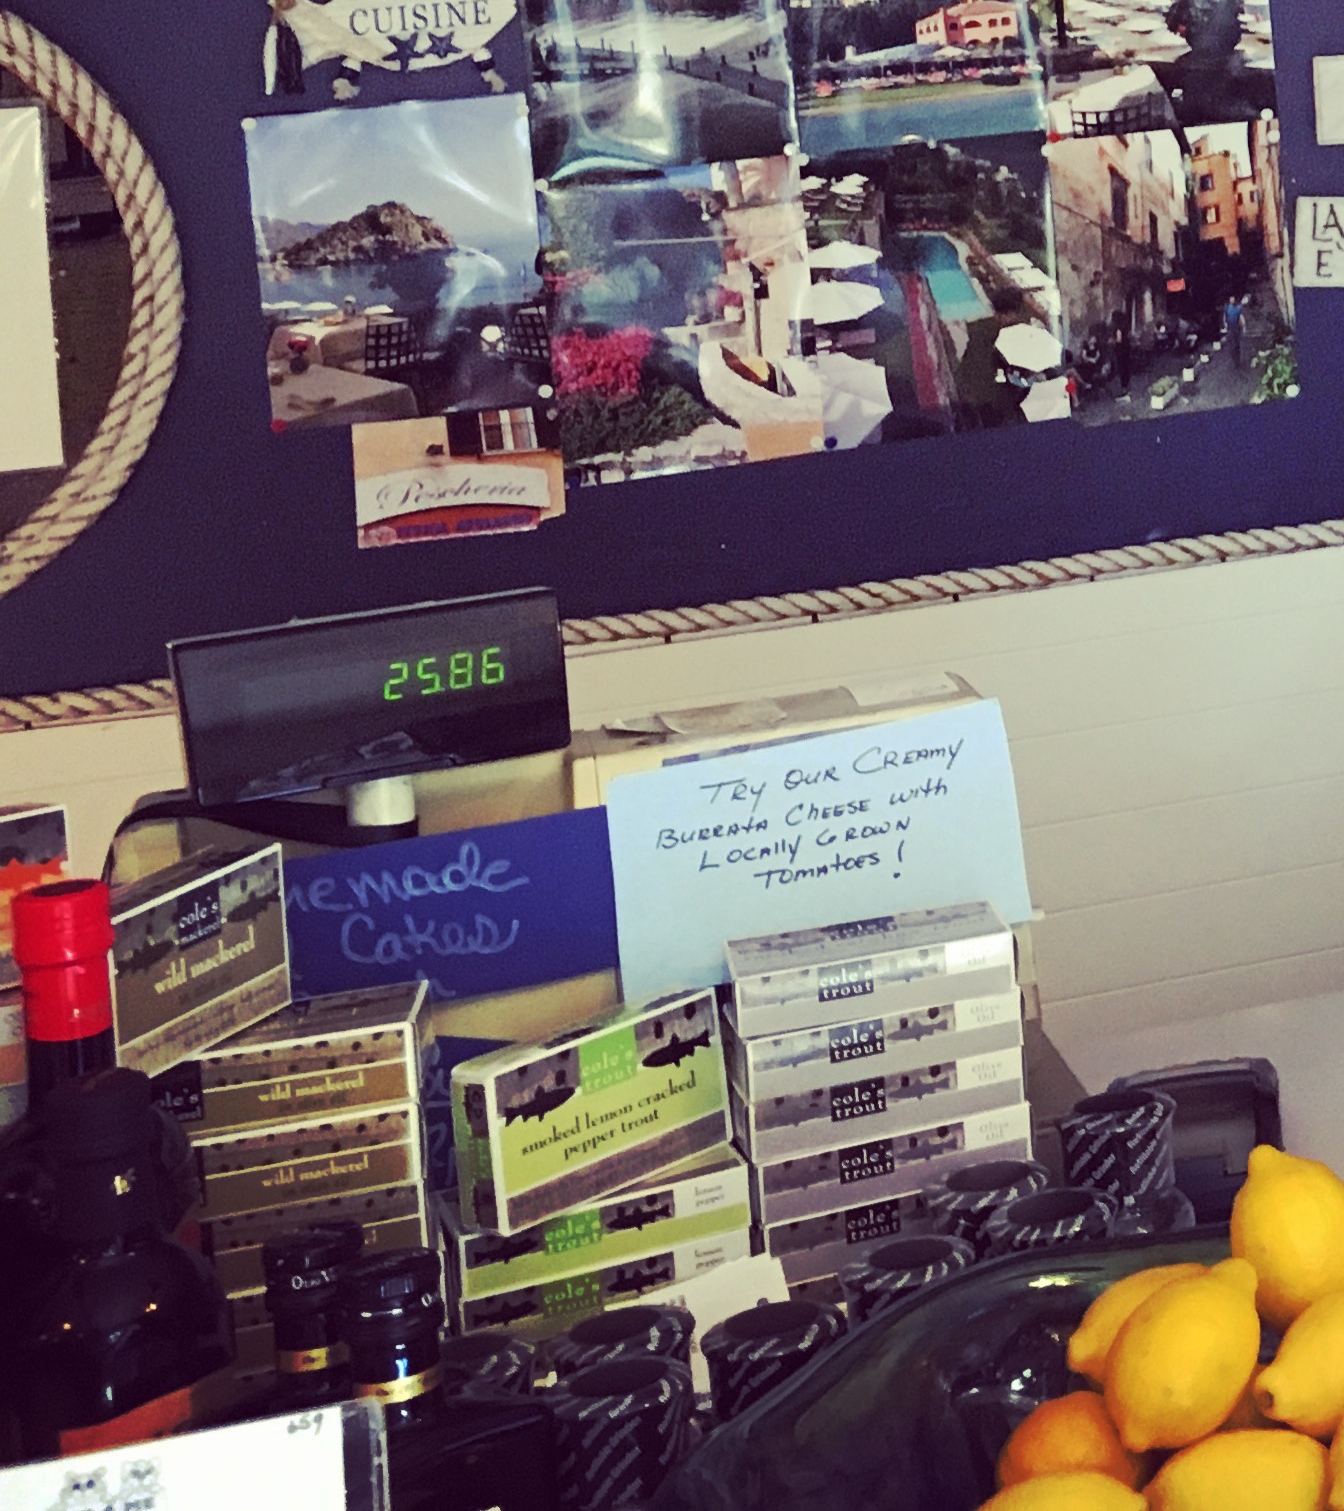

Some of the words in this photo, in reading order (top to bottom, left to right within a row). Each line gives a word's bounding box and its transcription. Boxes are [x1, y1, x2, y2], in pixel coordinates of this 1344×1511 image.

[350, 0, 491, 36] CUISINE
[700, 777, 767, 813] TRY
[783, 765, 841, 791] OUR
[852, 738, 965, 776] CREAMY
[656, 818, 769, 851] BURRATA
[785, 799, 871, 826] CHEESE
[889, 779, 948, 806] with
[699, 836, 799, 872] LOCALLY
[816, 816, 911, 846] GROWN
[341, 914, 521, 965] Cakes
[154, 957, 187, 994] wild
[190, 924, 256, 978] mackerel
[822, 979, 874, 1000] trout
[830, 1023, 883, 1048] cole's
[581, 1043, 635, 1078] cole's
[834, 1041, 883, 1061] trout
[258, 1082, 291, 1102] wild
[295, 1071, 365, 1097] mackerel
[832, 1082, 886, 1108] cole's
[521, 1115, 582, 1157] smoked
[586, 1104, 634, 1130] lemon
[637, 1070, 698, 1109] cracked
[835, 1100, 885, 1119] trout
[563, 1127, 617, 1161] pepper
[621, 1108, 660, 1134] trout
[841, 1143, 894, 1170] cole's
[262, 1167, 295, 1187] wild
[844, 1162, 895, 1183] trout
[847, 1203, 900, 1230] cole's
[851, 1221, 900, 1241] trout
